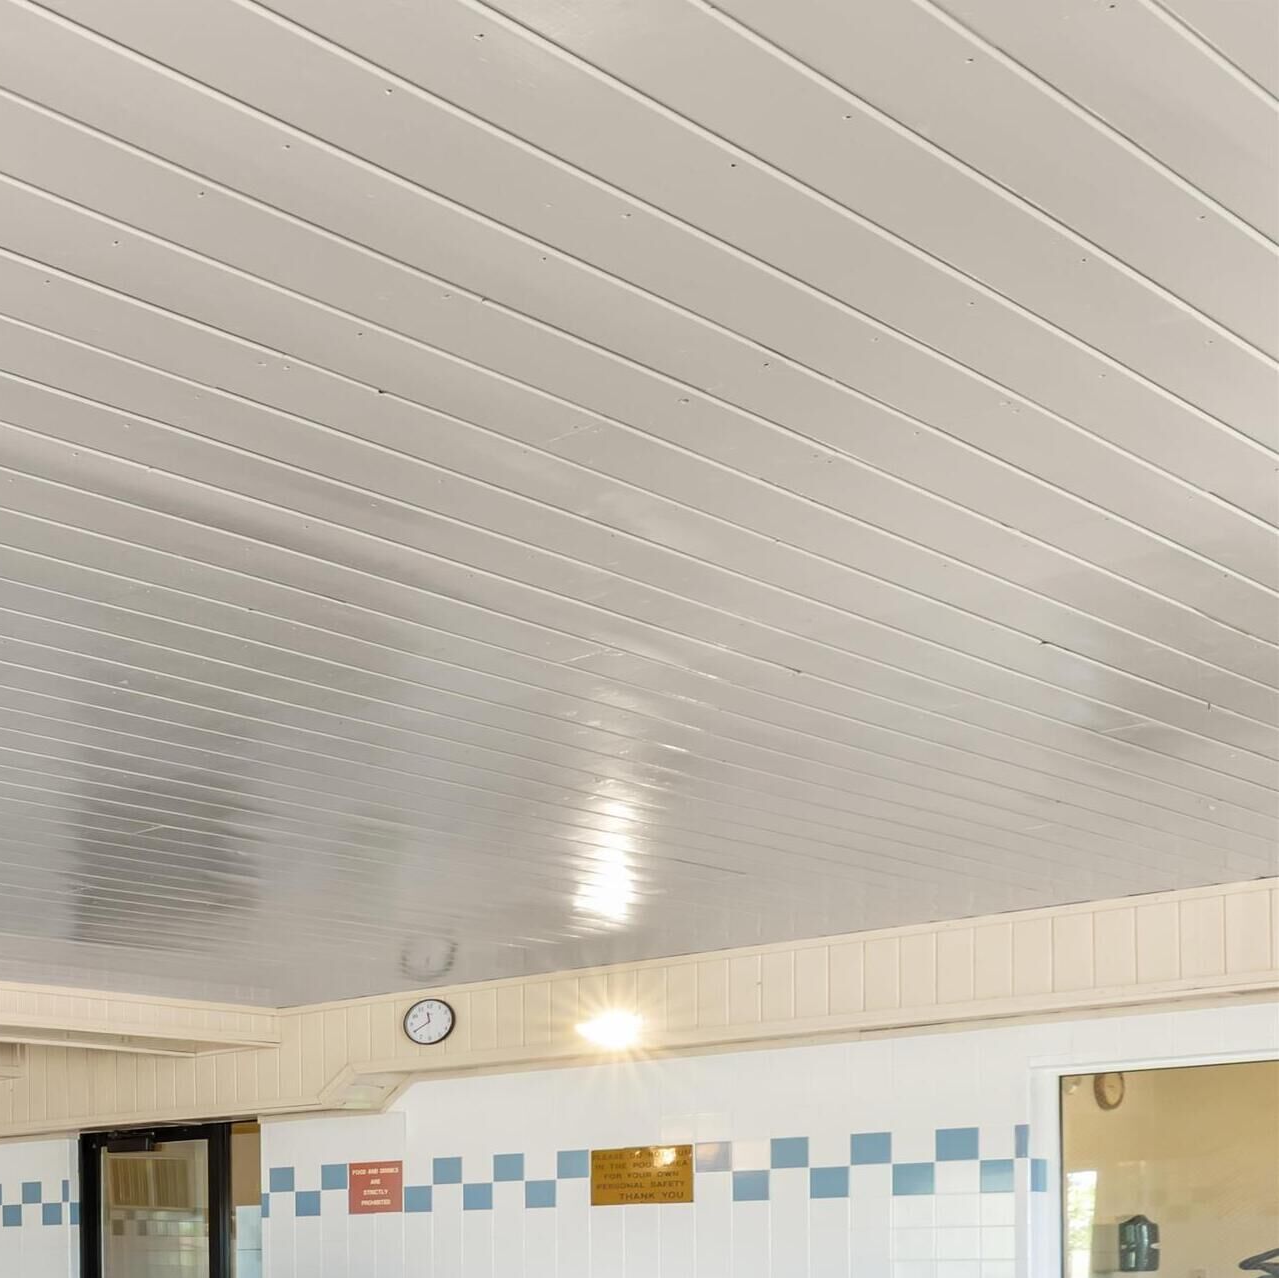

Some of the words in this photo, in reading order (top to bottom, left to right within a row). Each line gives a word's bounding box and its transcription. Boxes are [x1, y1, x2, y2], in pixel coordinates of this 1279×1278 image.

[627, 1171, 652, 1179] YOUR
[596, 1182, 644, 1190] PERSONAL
[651, 1180, 685, 1188] SAFETY
[619, 1191, 655, 1200] THANK
[663, 1191, 684, 1199] YOU
